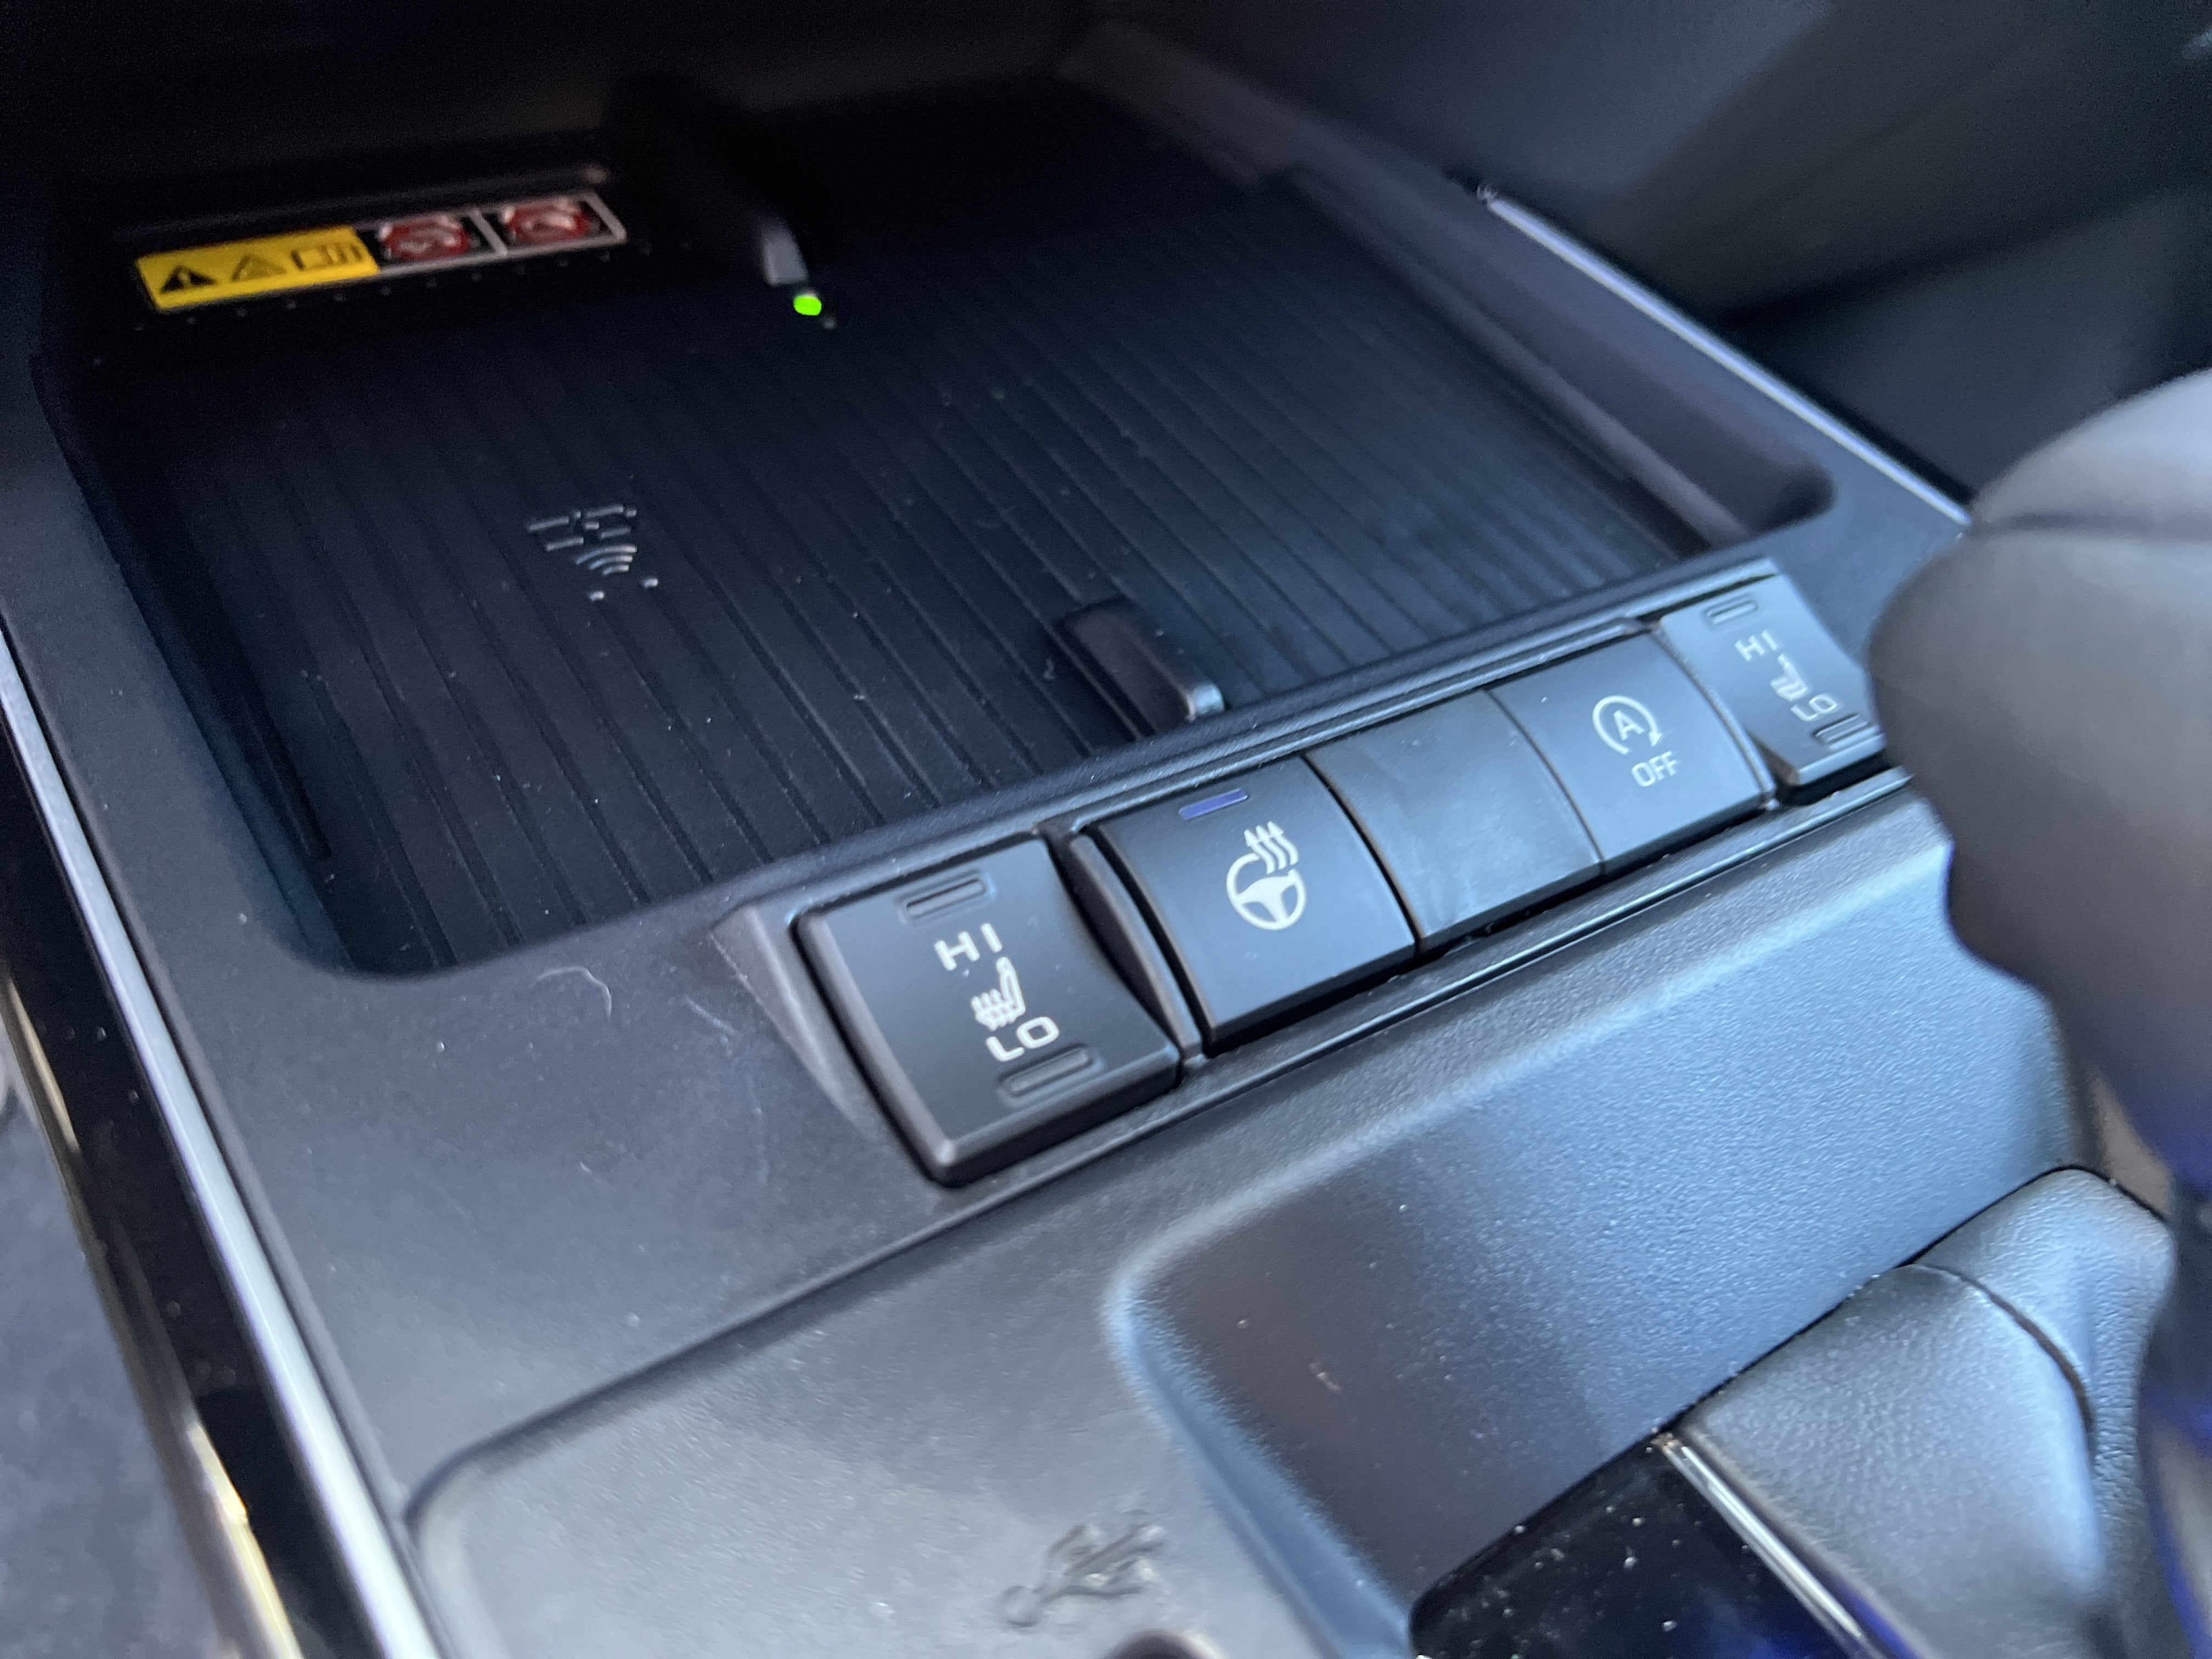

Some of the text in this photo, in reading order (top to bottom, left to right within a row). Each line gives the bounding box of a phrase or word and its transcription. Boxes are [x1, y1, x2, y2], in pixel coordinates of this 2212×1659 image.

[1735, 630, 1780, 662] HI
[1791, 694, 1839, 722] LO
[1631, 750, 1679, 787] OFF
[935, 923, 1002, 970] HI
[986, 1016, 1059, 1062] LO
